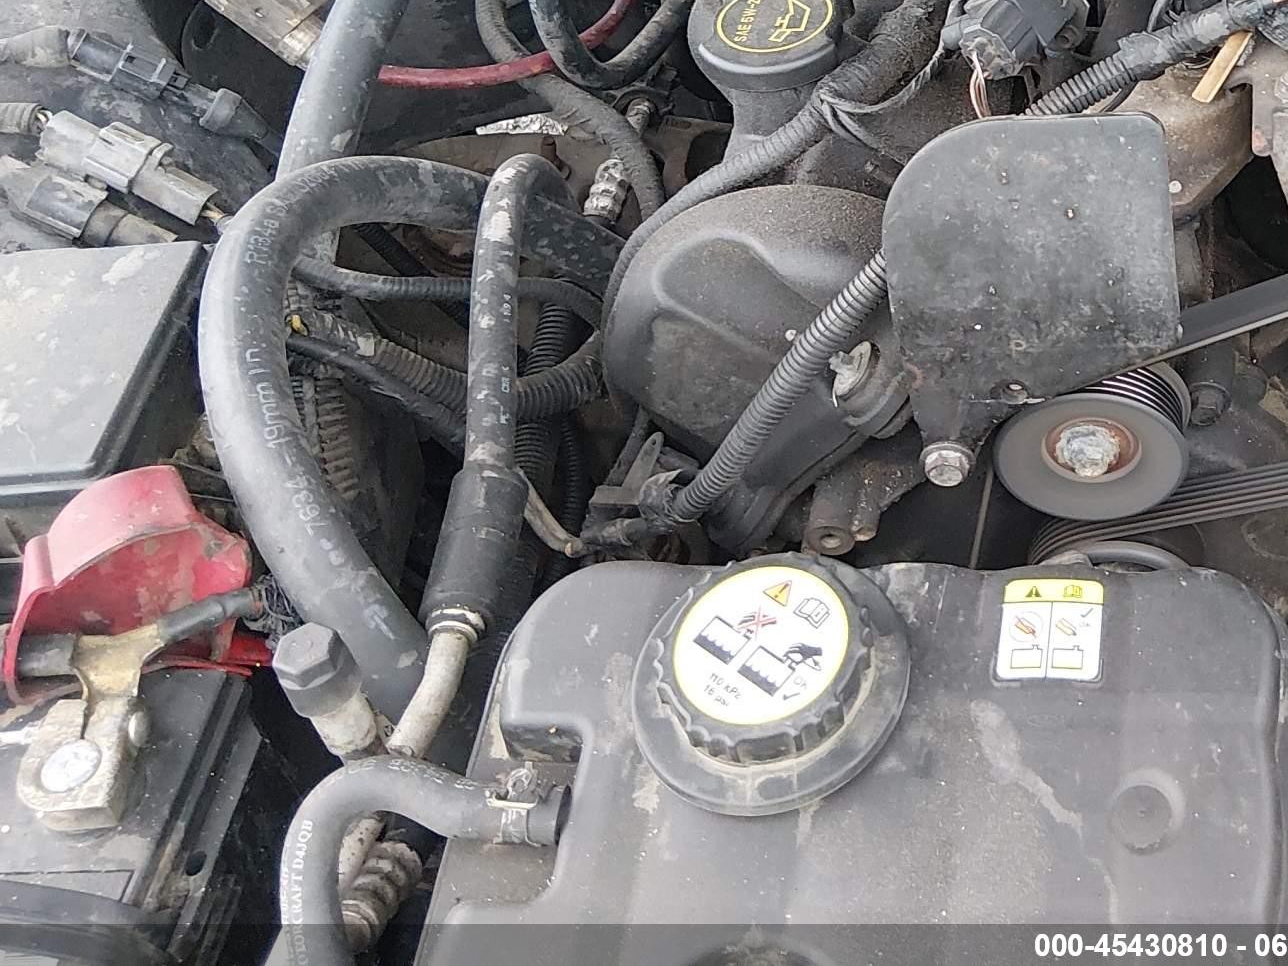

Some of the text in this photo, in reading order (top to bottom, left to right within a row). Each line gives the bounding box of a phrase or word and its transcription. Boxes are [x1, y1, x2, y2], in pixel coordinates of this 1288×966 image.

[733, 24, 752, 43] SAE
[244, 218, 281, 265] R134a
[256, 381, 293, 450] 19mm
[703, 685, 715, 697] 16
